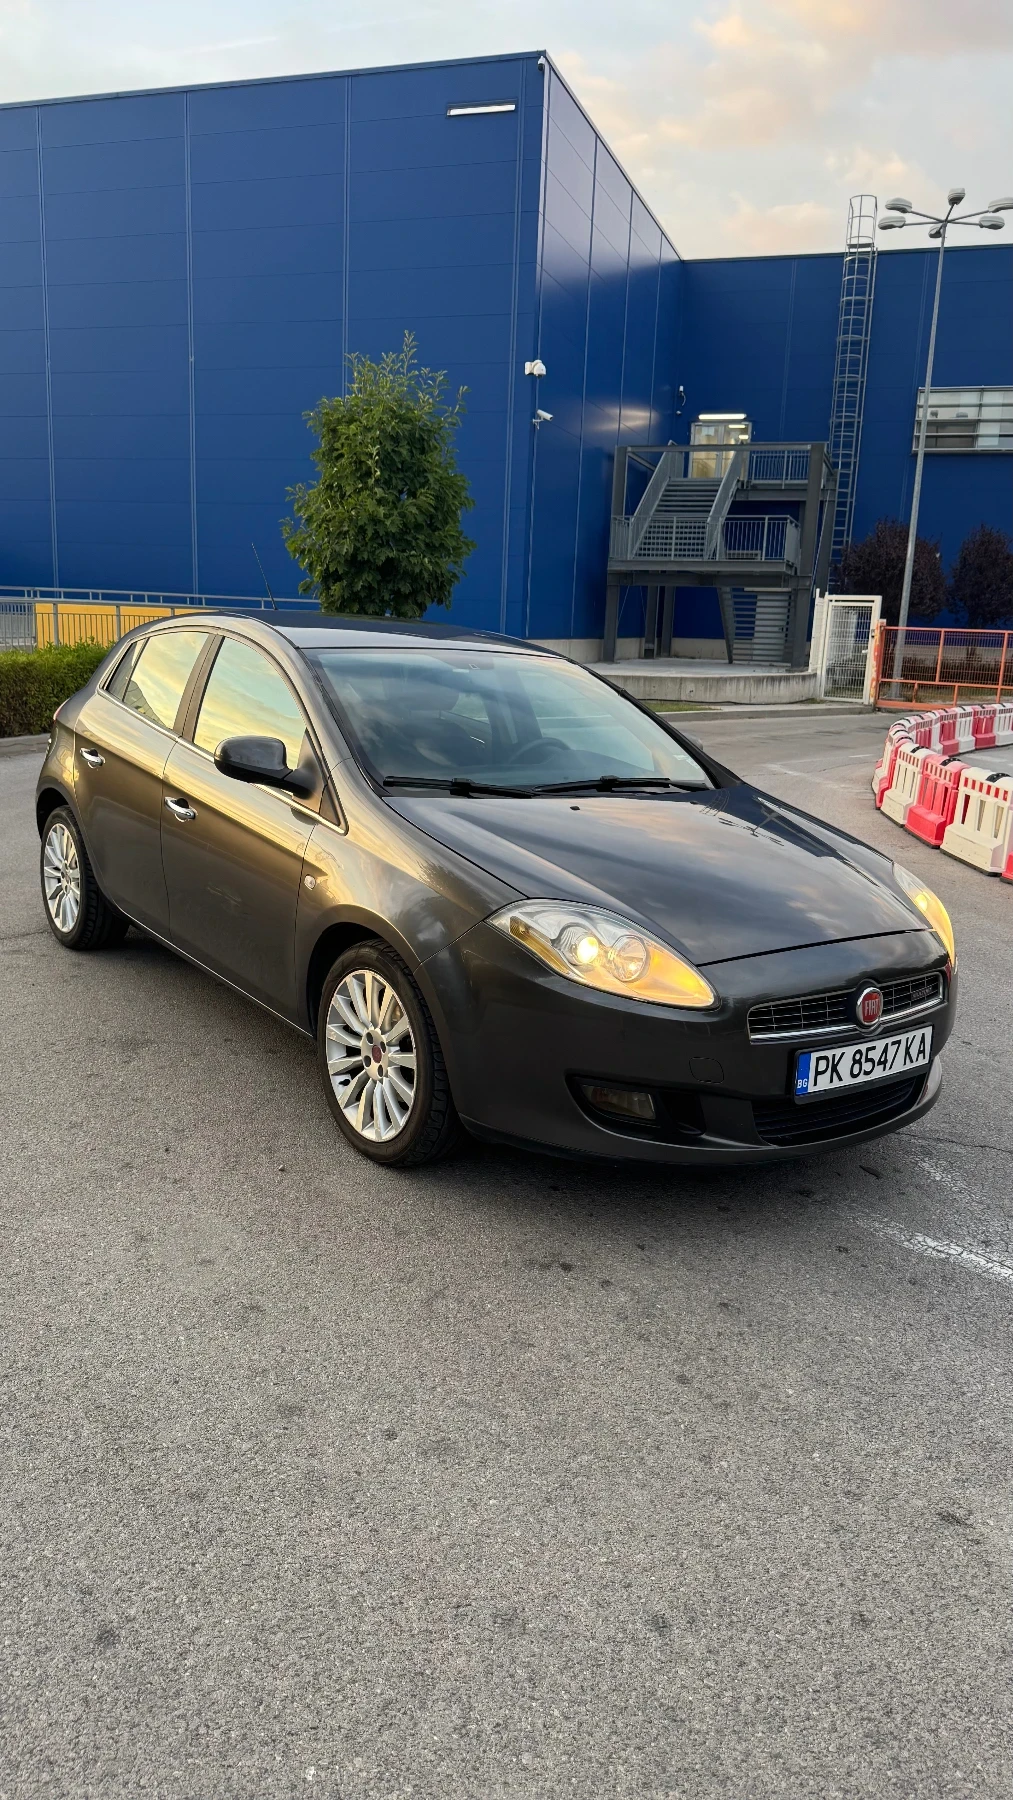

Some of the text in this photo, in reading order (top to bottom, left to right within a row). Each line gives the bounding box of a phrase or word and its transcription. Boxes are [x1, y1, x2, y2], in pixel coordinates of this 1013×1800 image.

[865, 999, 878, 1017] FIAT
[813, 1033, 926, 1087] PK 8547 KA
[797, 1079, 808, 1089] BG
